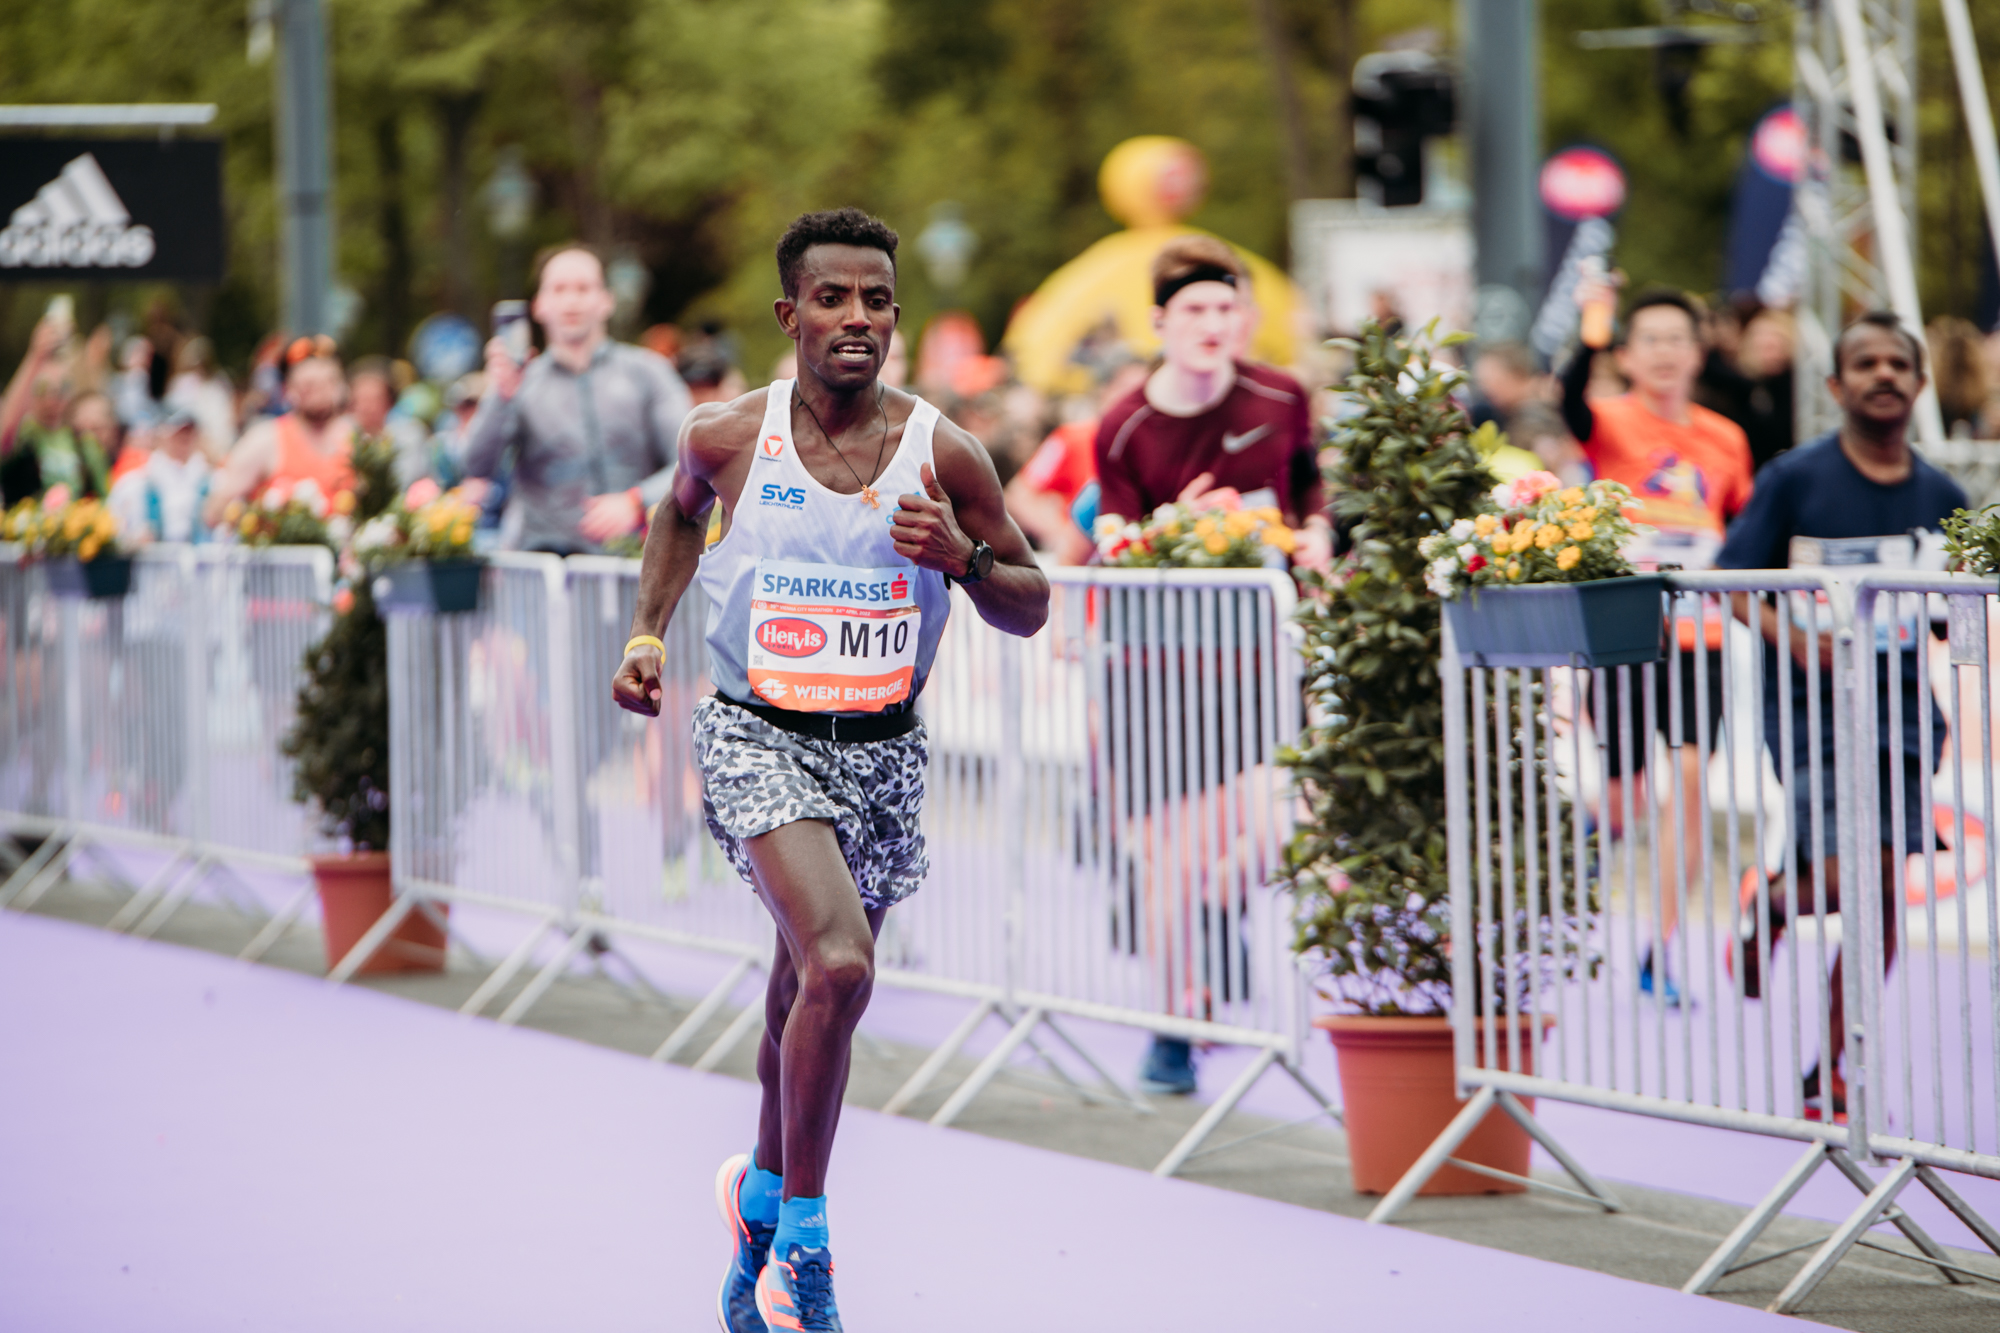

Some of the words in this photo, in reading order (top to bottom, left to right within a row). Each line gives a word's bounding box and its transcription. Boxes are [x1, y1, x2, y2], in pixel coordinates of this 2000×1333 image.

[761, 484, 806, 504] SVS
[762, 573, 890, 601] SPARKASSE
[780, 604, 797, 612] VIENNA
[763, 623, 822, 650] Hervis
[839, 620, 908, 658] M10
[793, 684, 840, 701] WIEN
[844, 678, 904, 701] ENERGIE
